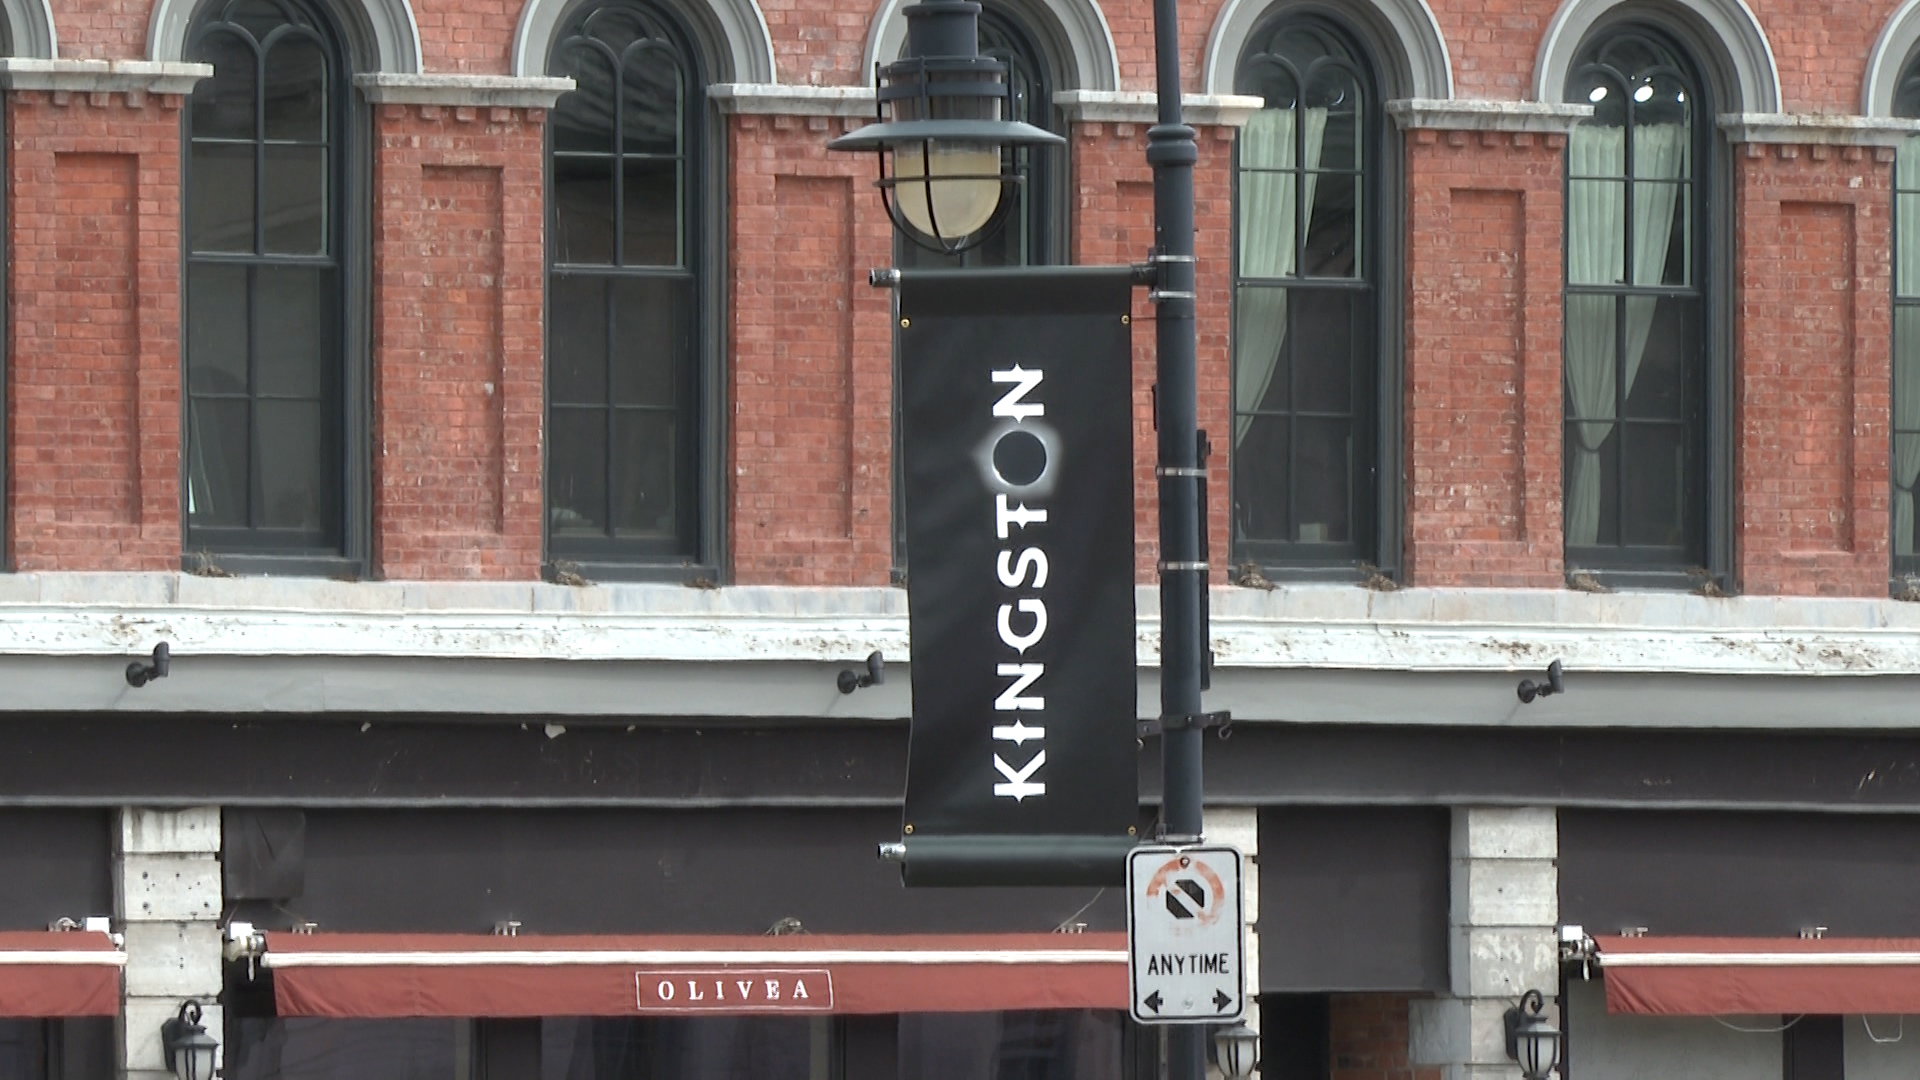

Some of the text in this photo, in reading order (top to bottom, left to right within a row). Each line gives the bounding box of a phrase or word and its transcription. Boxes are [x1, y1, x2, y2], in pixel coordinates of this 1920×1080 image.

[990, 363, 1048, 802] KINGSTON
[1147, 953, 1229, 975] ANYTIME
[658, 979, 809, 1000] OLIVEA
